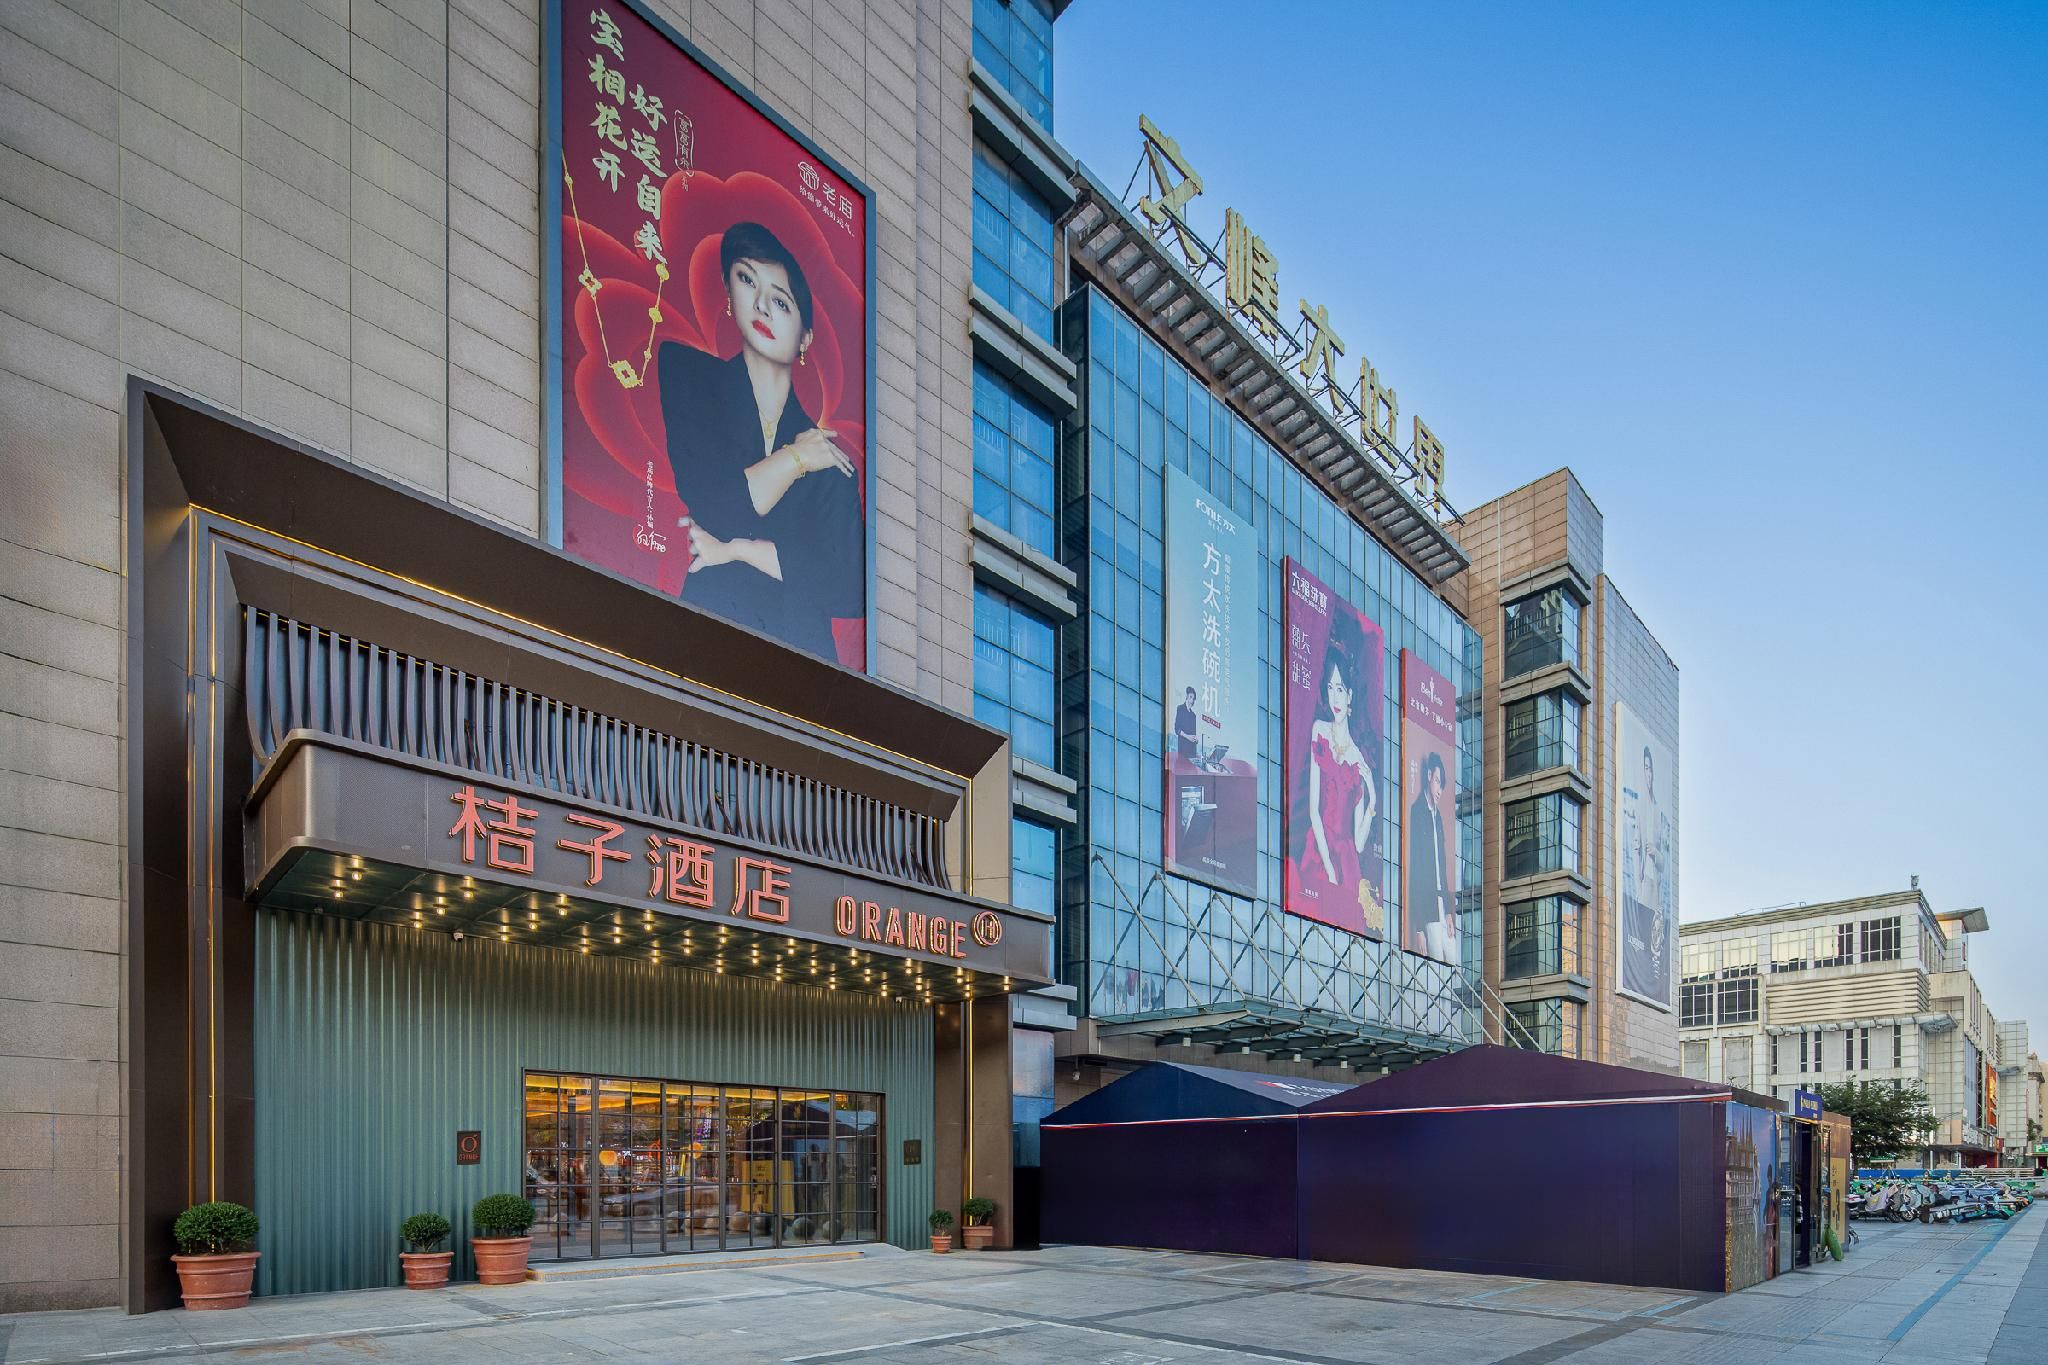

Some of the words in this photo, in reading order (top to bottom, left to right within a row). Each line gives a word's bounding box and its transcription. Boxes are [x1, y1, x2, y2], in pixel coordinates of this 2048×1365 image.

[822, 182, 853, 220] 老庙
[1201, 542, 1221, 718] 方太洗碗机
[449, 785, 792, 924] 桔子酒店
[836, 895, 969, 960] ORANGE
